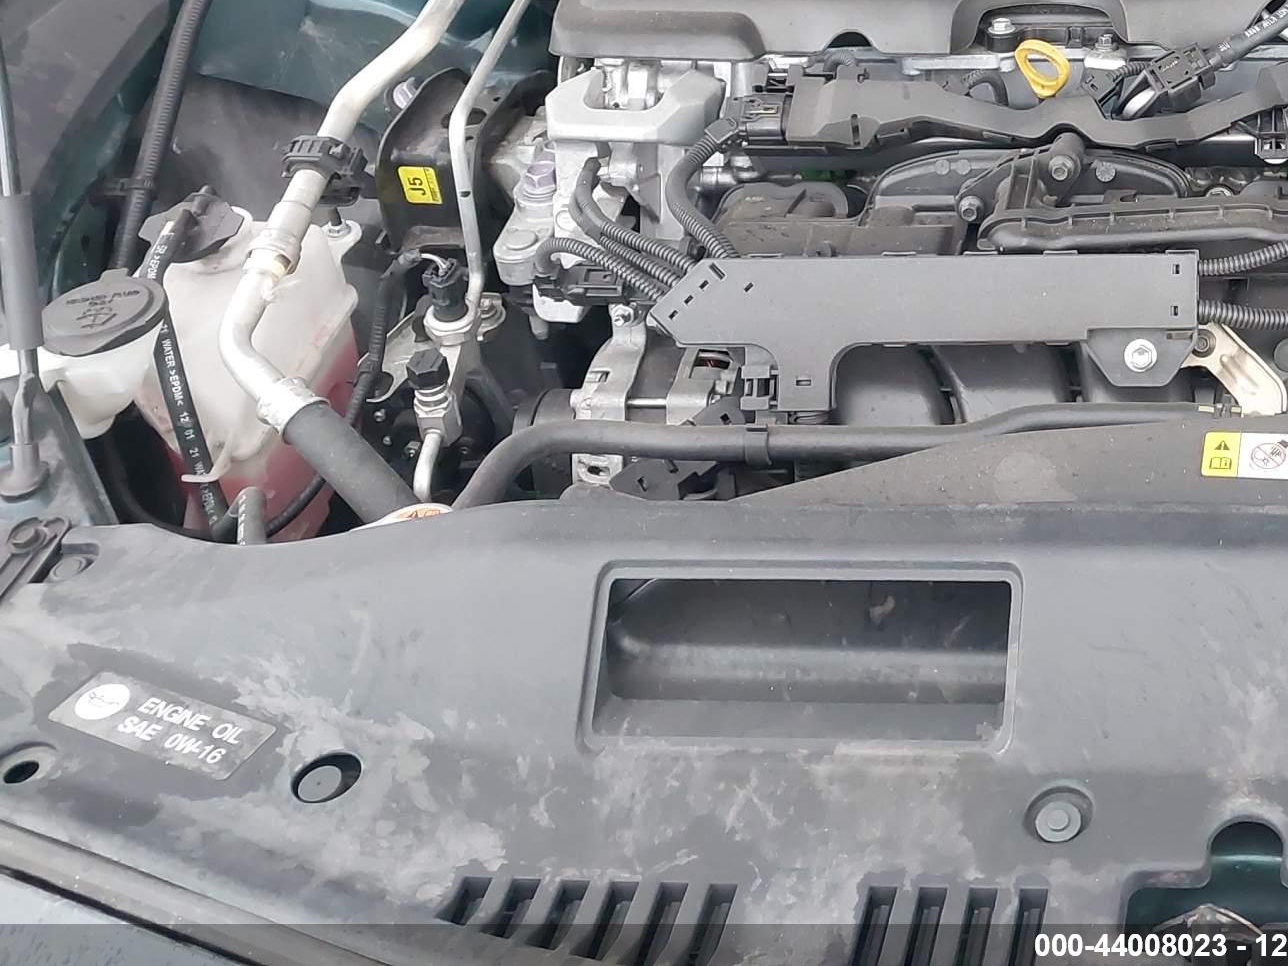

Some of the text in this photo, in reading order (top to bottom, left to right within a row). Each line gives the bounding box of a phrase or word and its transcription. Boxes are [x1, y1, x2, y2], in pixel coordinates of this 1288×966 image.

[407, 177, 426, 196] J5
[161, 339, 176, 369] WATER
[178, 412, 189, 423] 12
[188, 447, 200, 458] 21
[117, 716, 226, 764] SAE 0W-16
[137, 696, 245, 744] ENGINE OIL
